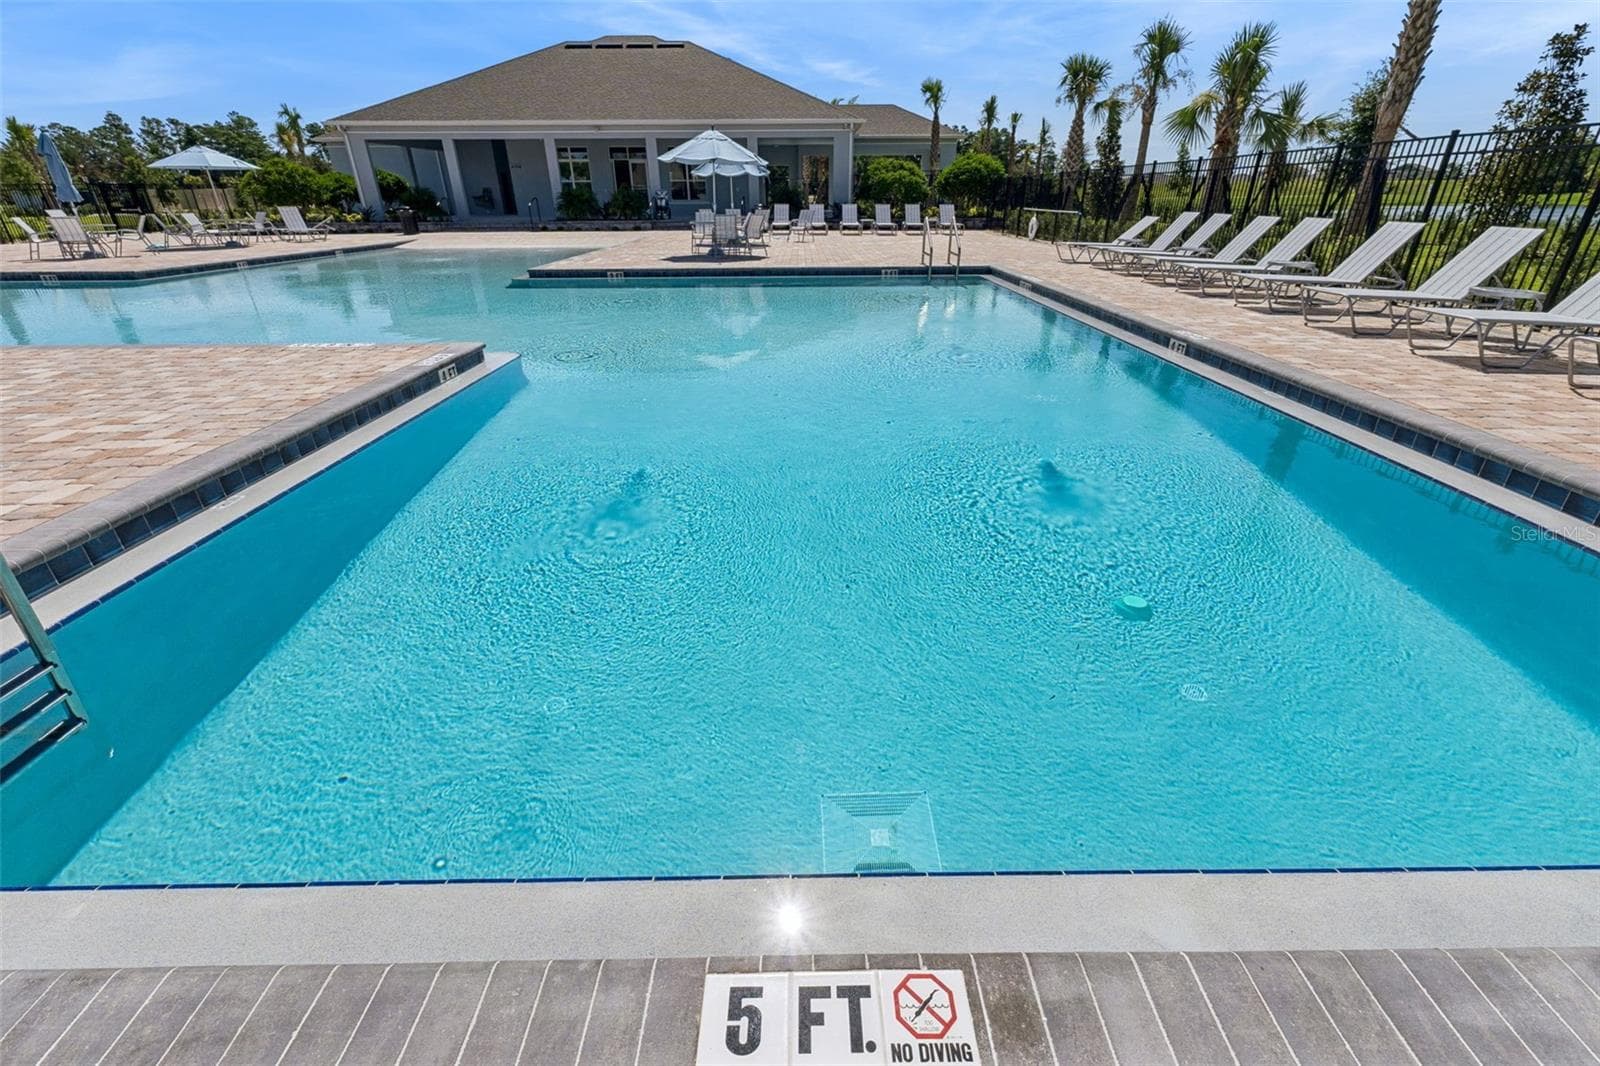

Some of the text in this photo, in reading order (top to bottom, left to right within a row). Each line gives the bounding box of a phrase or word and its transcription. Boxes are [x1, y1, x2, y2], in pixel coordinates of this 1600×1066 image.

[725, 985, 877, 1056] 5 FT.
[890, 1042, 974, 1063] NO DIVING
